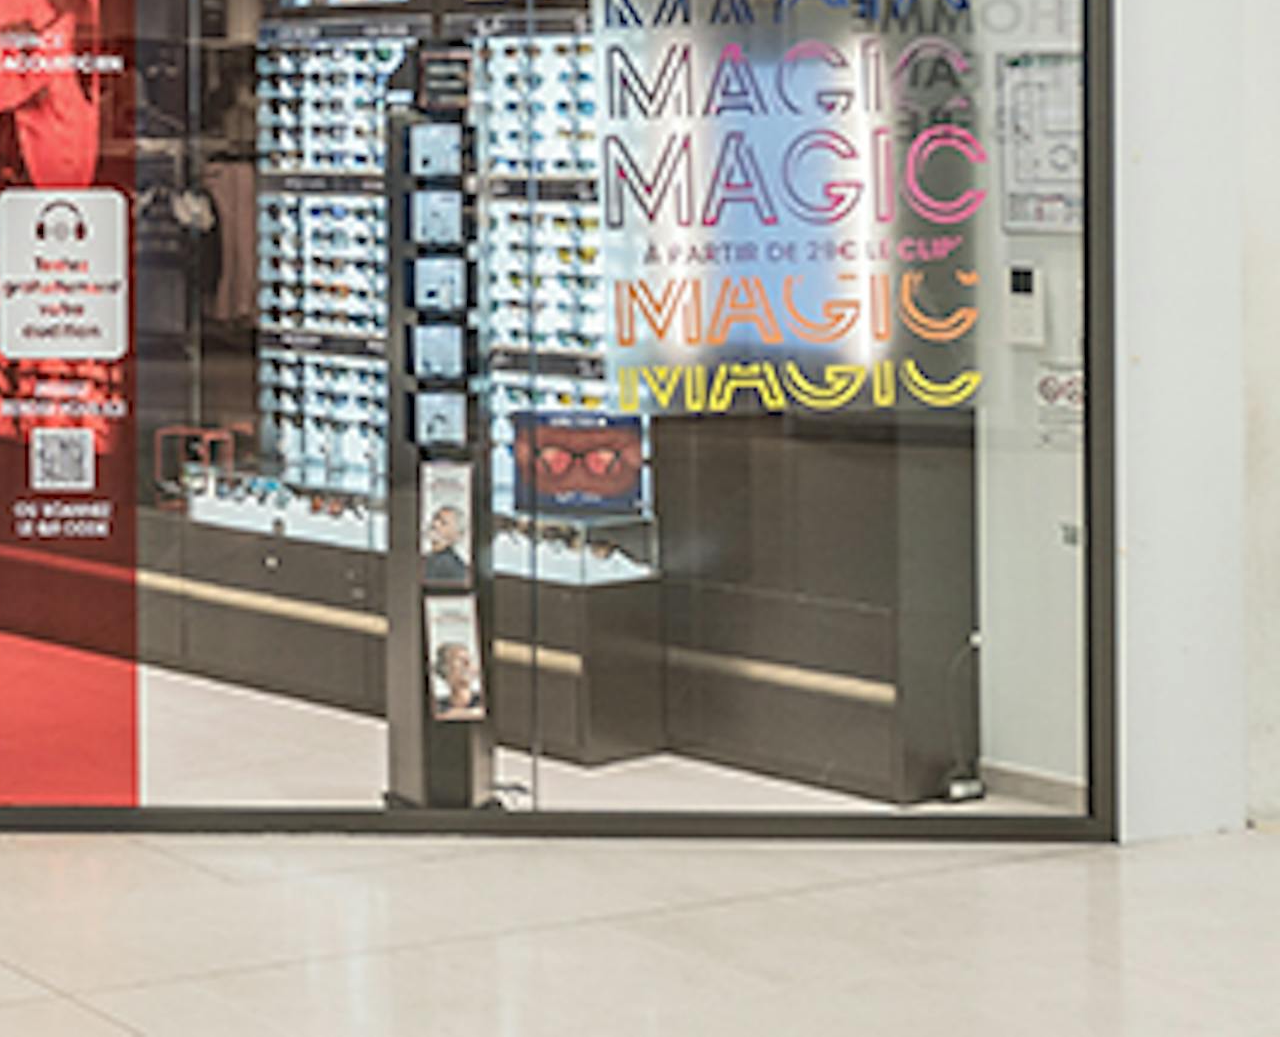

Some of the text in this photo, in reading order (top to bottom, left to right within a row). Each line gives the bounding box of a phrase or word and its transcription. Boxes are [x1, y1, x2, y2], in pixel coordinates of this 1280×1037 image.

[607, 38, 969, 118] MAGIC
[603, 124, 988, 229] MAGIC
[668, 239, 758, 265] PARTIR
[765, 239, 796, 264] DE
[615, 273, 979, 345] MAGIC
